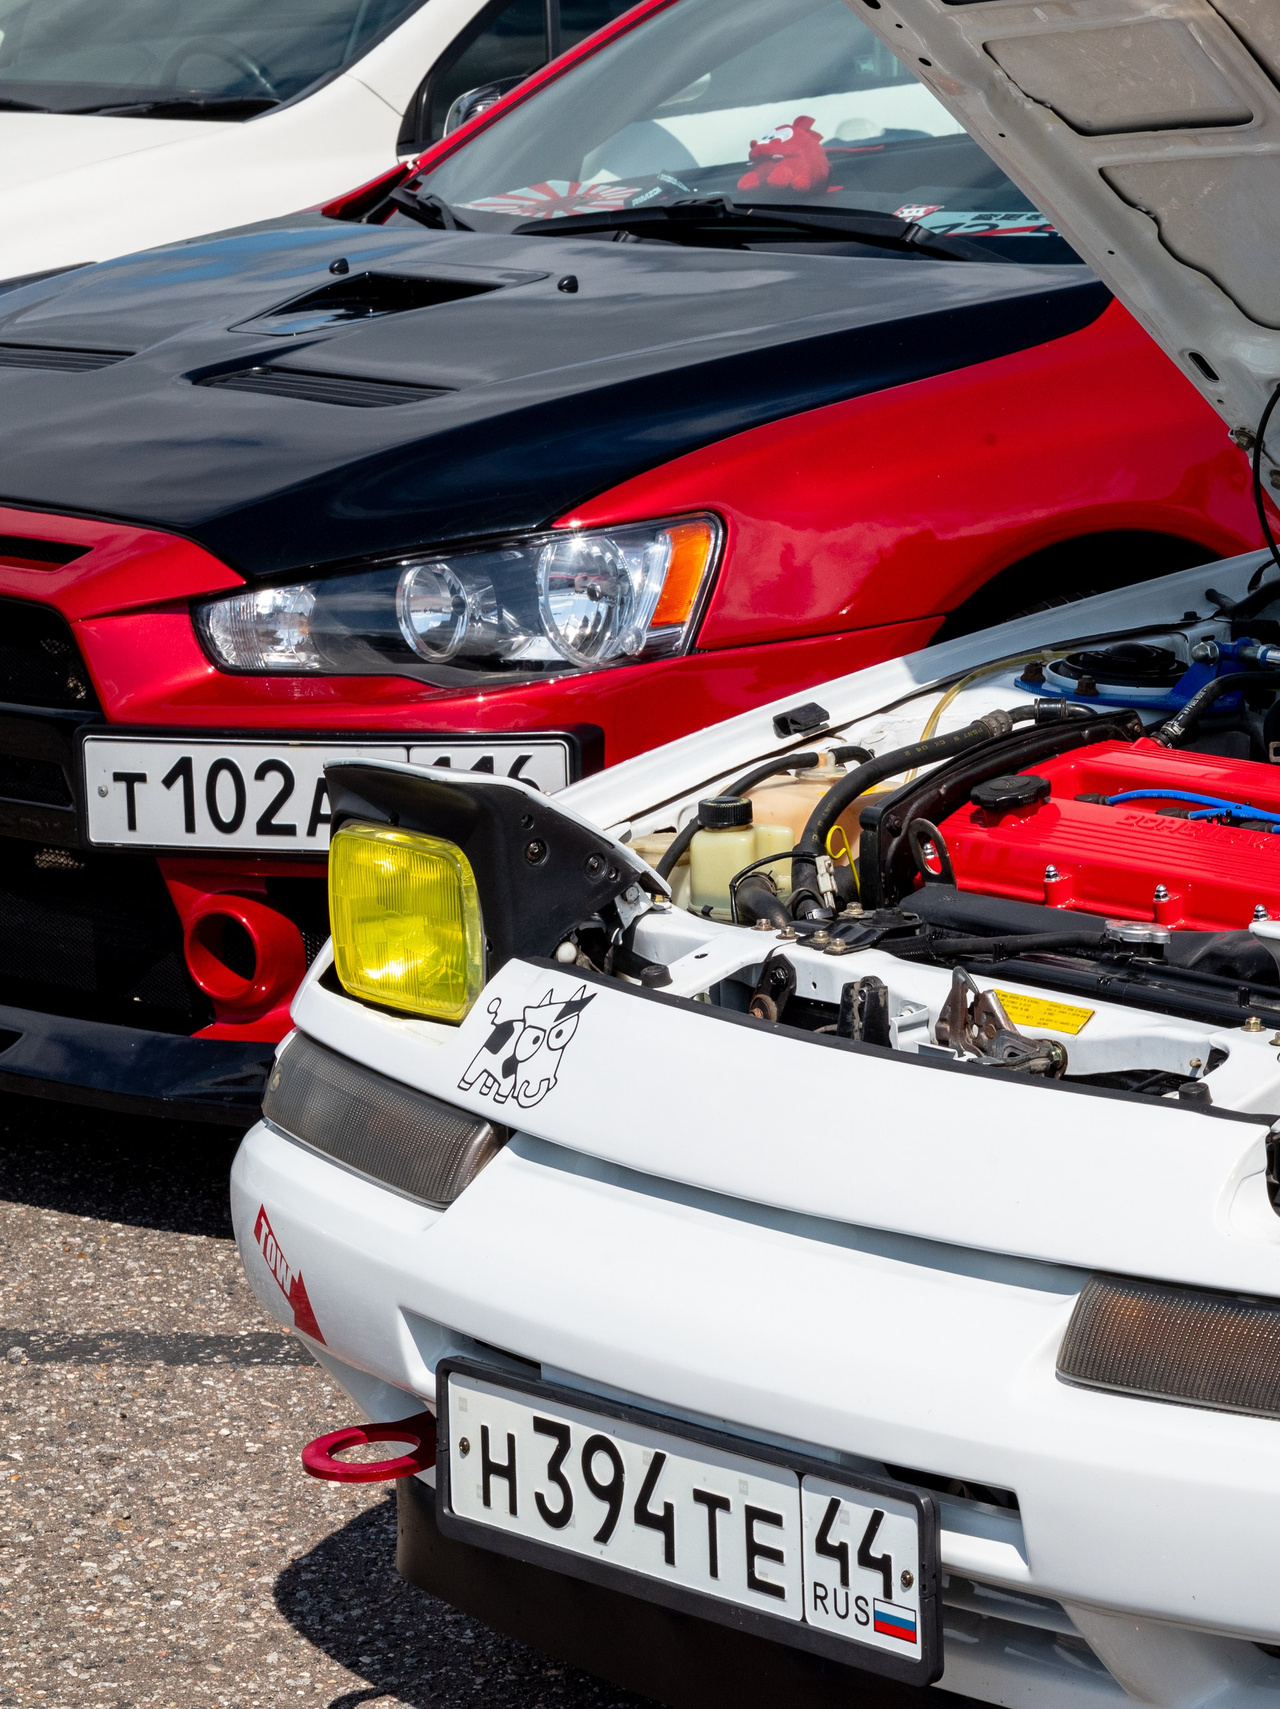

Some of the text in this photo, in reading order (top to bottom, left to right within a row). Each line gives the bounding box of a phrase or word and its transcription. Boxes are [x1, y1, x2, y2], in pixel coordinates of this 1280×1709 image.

[480, 1415, 894, 1600] H394TE 44
[812, 1581, 871, 1628] RUS
